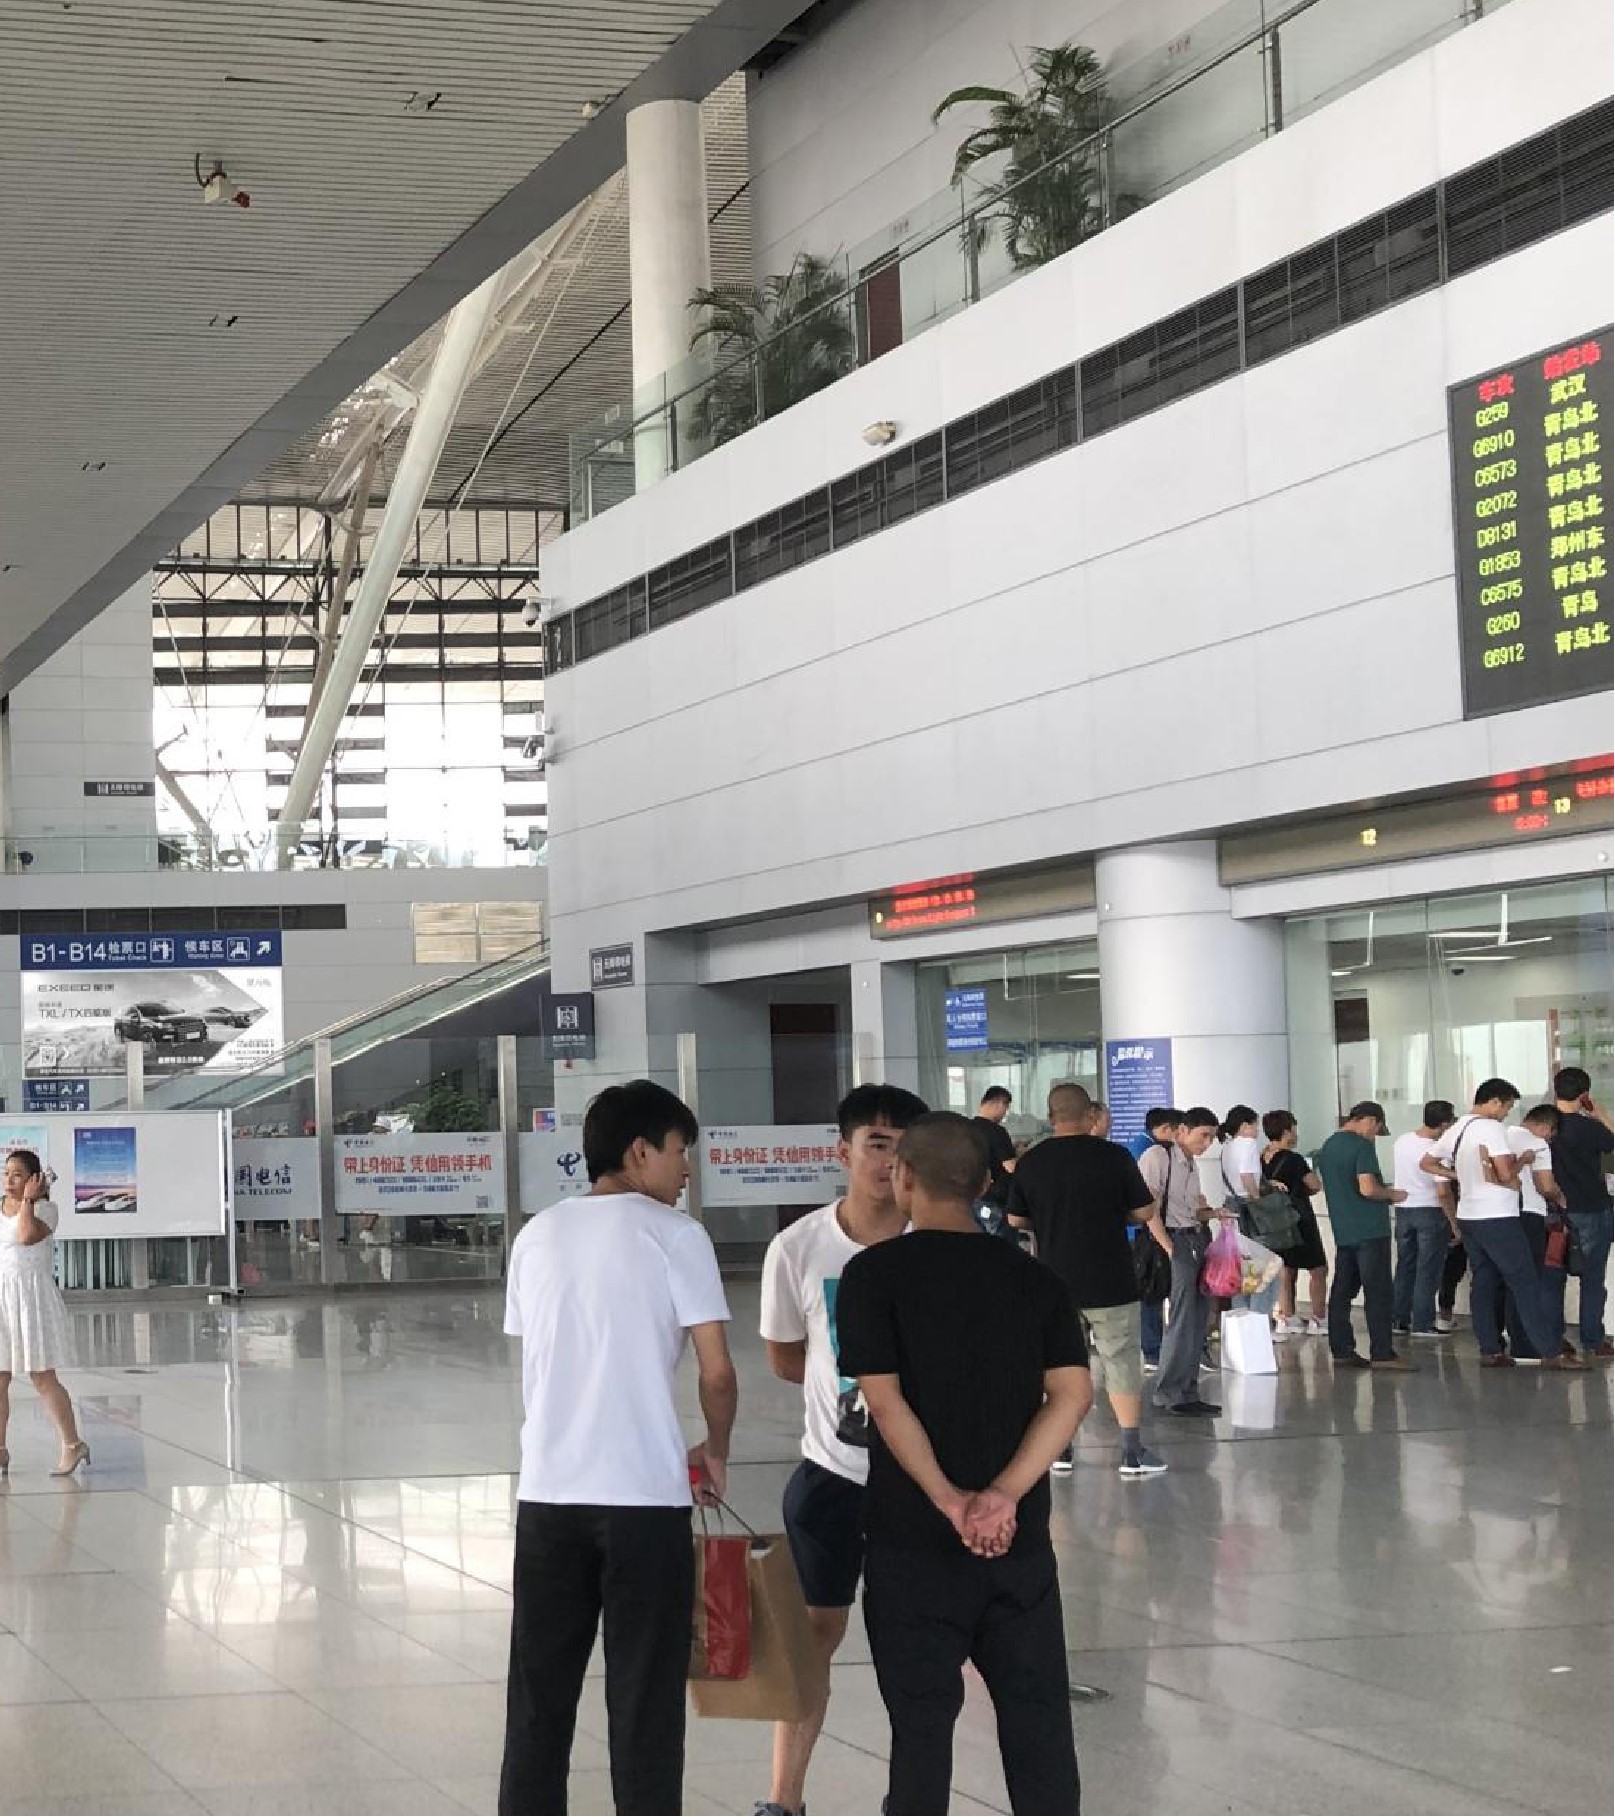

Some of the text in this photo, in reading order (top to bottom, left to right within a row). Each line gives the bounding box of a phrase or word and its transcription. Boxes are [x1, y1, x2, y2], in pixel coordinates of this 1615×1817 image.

[1544, 400, 1599, 437] 青岛北
[1545, 431, 1601, 468] 青岛北
[1546, 462, 1602, 498] 青岛北
[1549, 494, 1605, 530] 青岛北
[1477, 520, 1517, 548] D8131
[1551, 556, 1607, 590] 青岛北
[1561, 589, 1598, 618] 青岛
[1555, 621, 1611, 656] 青岛北
[31, 943, 107, 963] B1-B14
[344, 1154, 492, 1174] 带上身份证 凭信用领手机
[709, 1145, 837, 1165] 带上身份证 凭信用领手
[234, 1163, 290, 1186] 国电信
